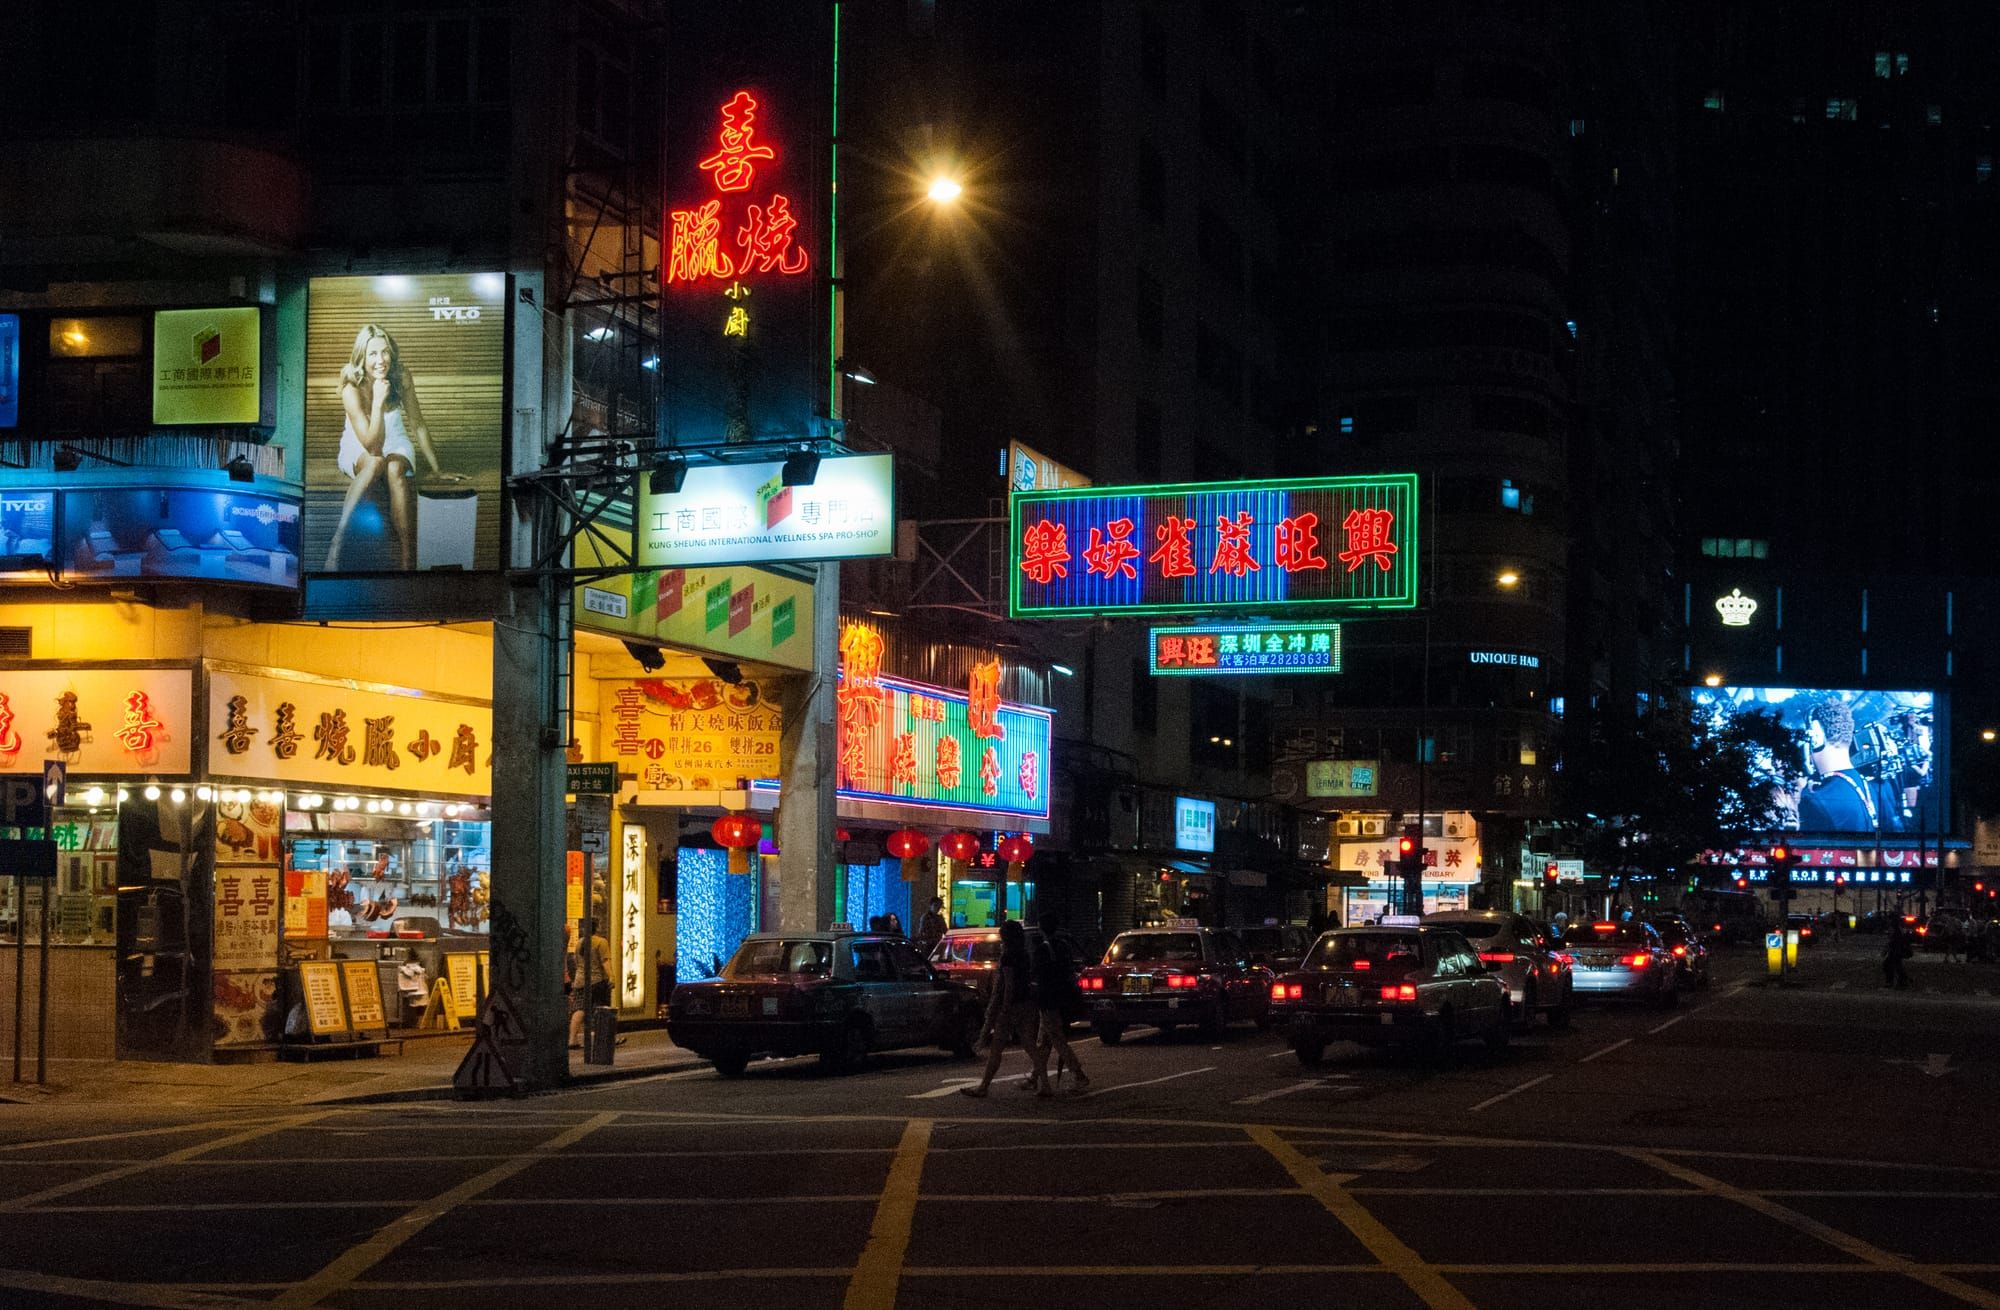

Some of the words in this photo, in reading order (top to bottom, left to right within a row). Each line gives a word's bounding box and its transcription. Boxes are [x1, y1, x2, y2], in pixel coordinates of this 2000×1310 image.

[649, 540, 672, 550] KUNG
[674, 538, 707, 549] SHEUNG
[708, 534, 773, 546] INTERNATIONAL
[775, 532, 817, 544] WELLNESS
[818, 531, 834, 541] SPA
[836, 529, 879, 540] PRO-SHOP
[1471, 652, 1518, 665] UNIQUE
[1520, 655, 1539, 668] HAIR
[219, 695, 493, 776] 喜喜燒臘小廚
[567, 767, 580, 775] AXI
[582, 767, 610, 775] STAND
[217, 875, 276, 916] 喜喜
